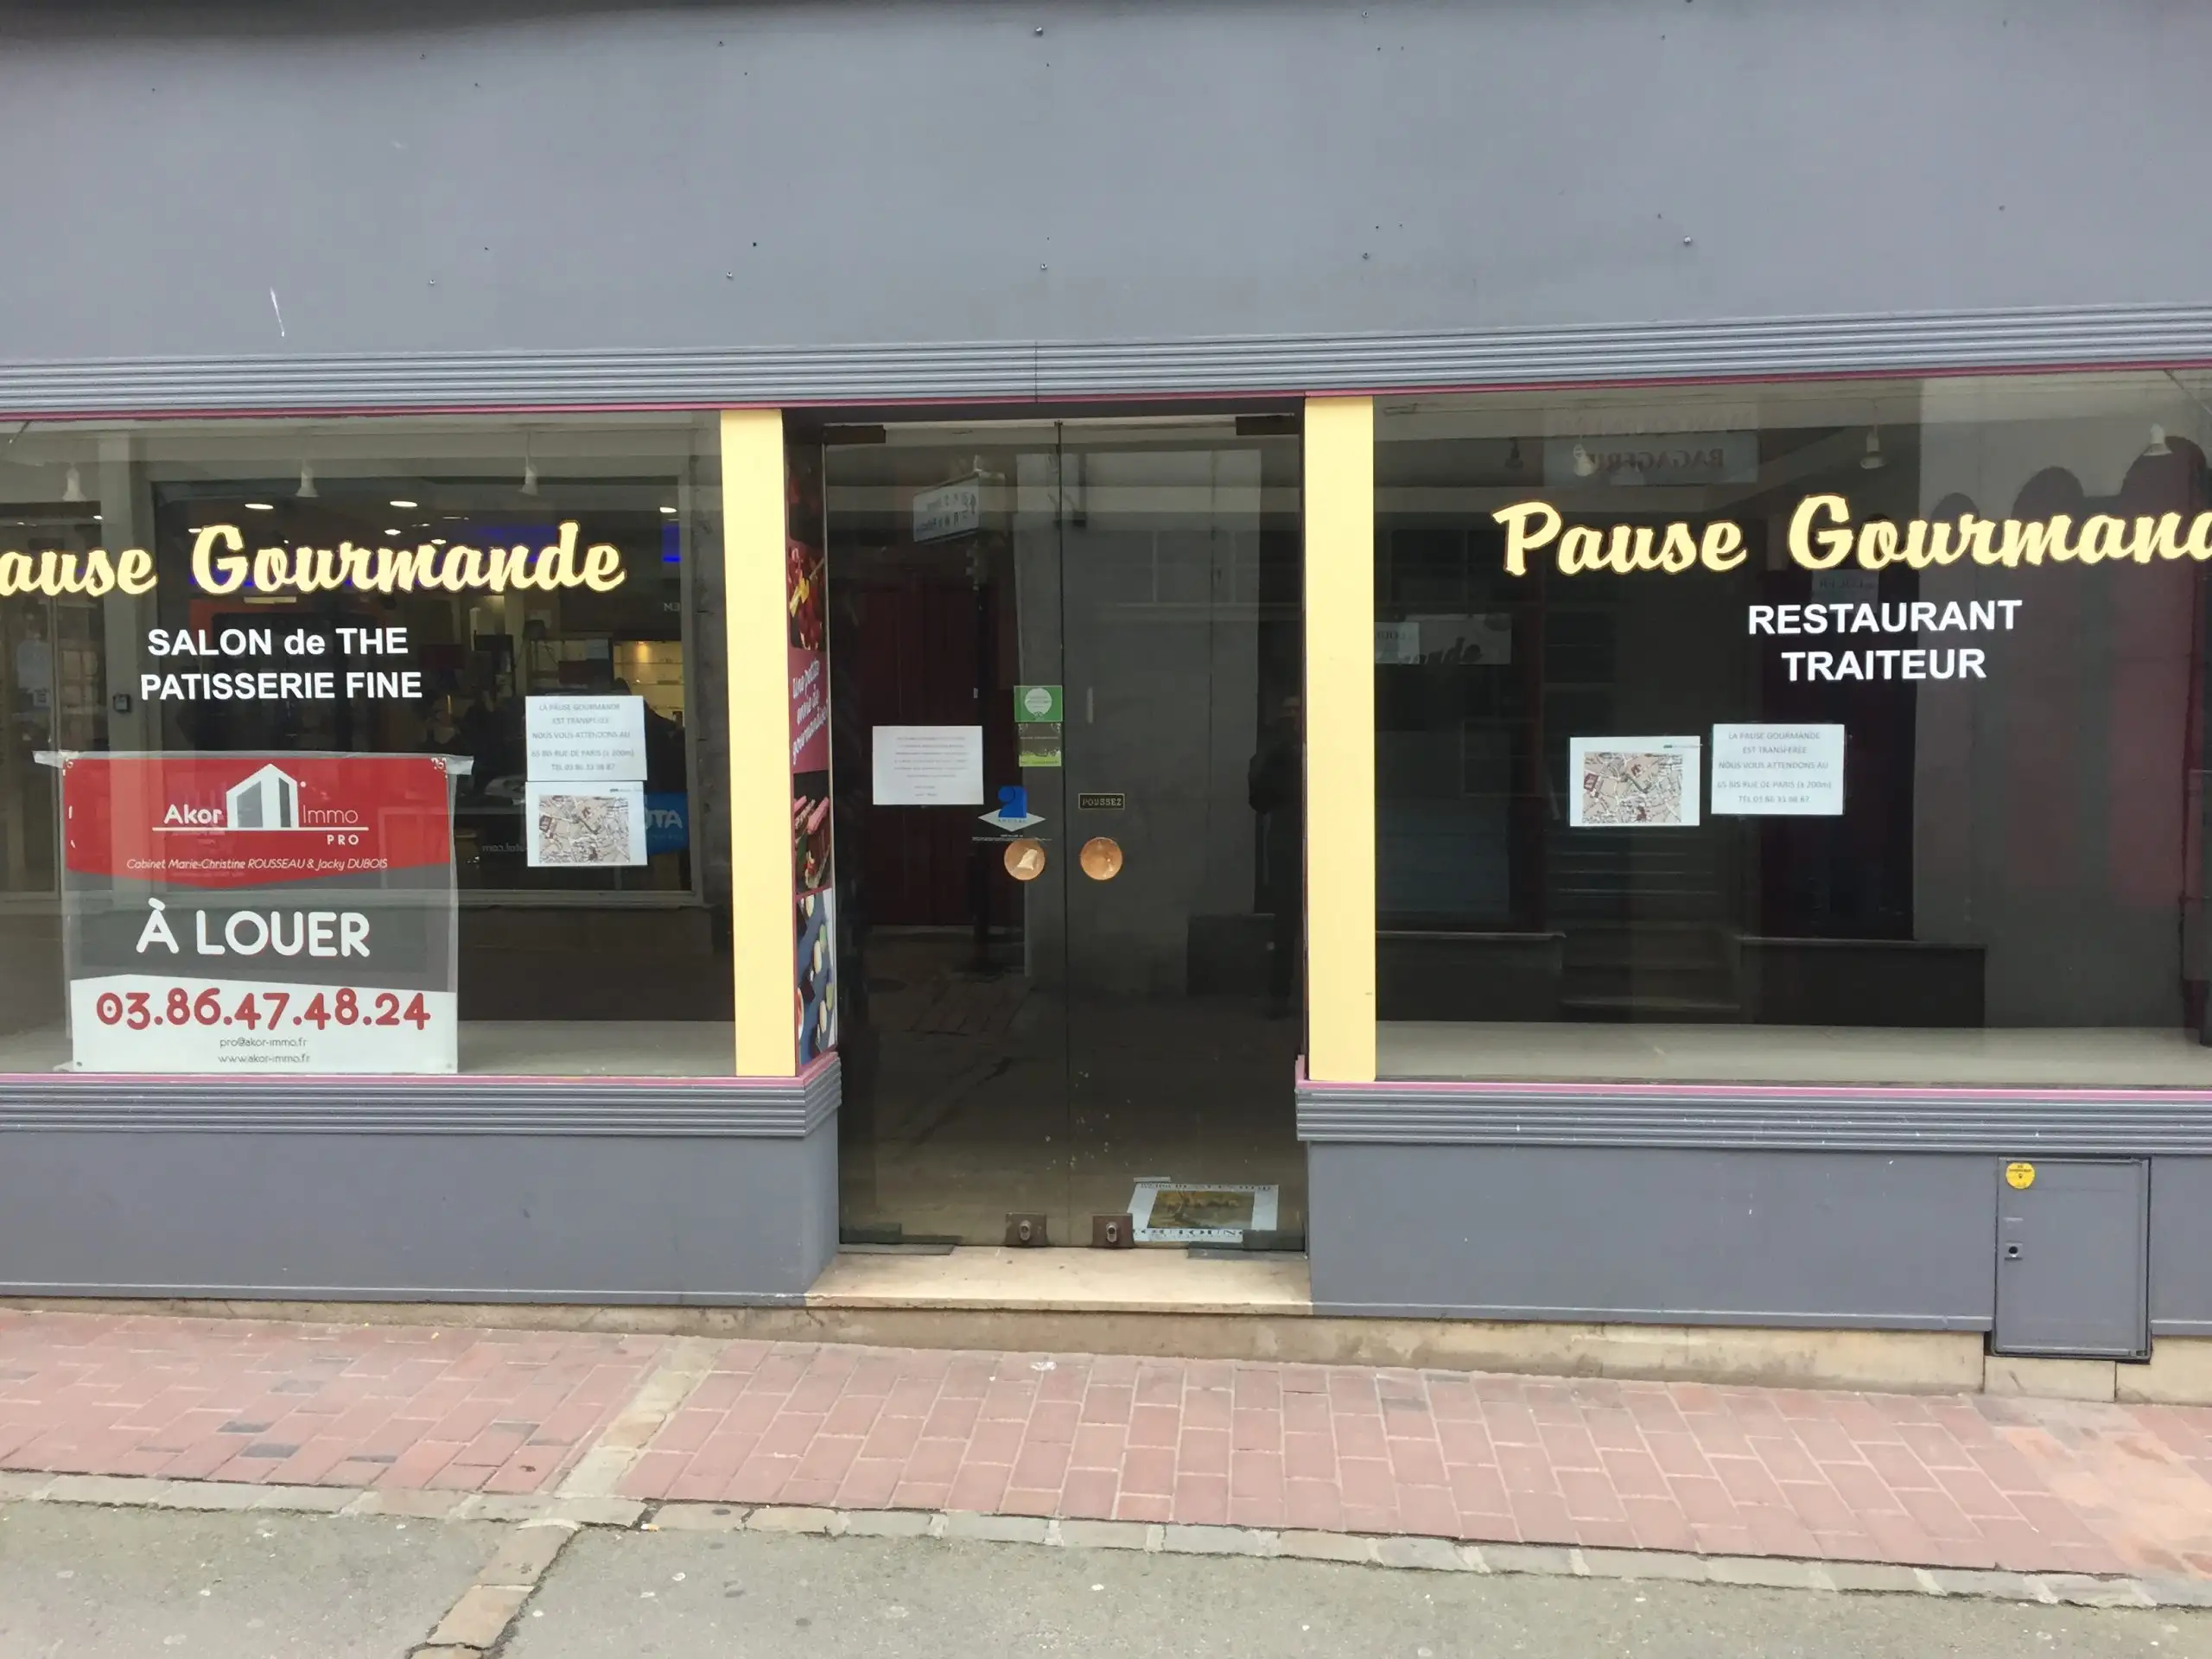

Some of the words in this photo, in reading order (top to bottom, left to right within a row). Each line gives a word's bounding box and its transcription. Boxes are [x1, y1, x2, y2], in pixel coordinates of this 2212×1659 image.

[1491, 499, 1748, 577] Pause
[191, 520, 627, 595] Gourmande
[1748, 600, 2023, 634] RESTAURANT
[148, 628, 271, 656] SALON
[283, 628, 326, 655] de
[335, 627, 409, 655] THE
[1781, 648, 1987, 681] TRAITEUR
[141, 672, 335, 701] PATISSERIE
[346, 671, 423, 698] FINE
[163, 804, 222, 824] Akor
[302, 804, 359, 823] Immo
[1082, 798, 1122, 806] POUSSEZ
[327, 834, 359, 845] PRO
[127, 858, 166, 869] Cabinet
[168, 858, 246, 870] Marie-Christine
[247, 858, 305, 869] ROUSSEAU
[307, 859, 314, 869] &
[315, 859, 346, 871] Jacky
[346, 858, 388, 869] DUBOIS
[136, 898, 180, 954] À
[195, 910, 371, 957] LOUER
[96, 987, 431, 1031] 03.86.47.48.24
[219, 1037, 308, 1049] pro@akor-immo.fr
[217, 1053, 310, 1064] www.akor-immo.fr
